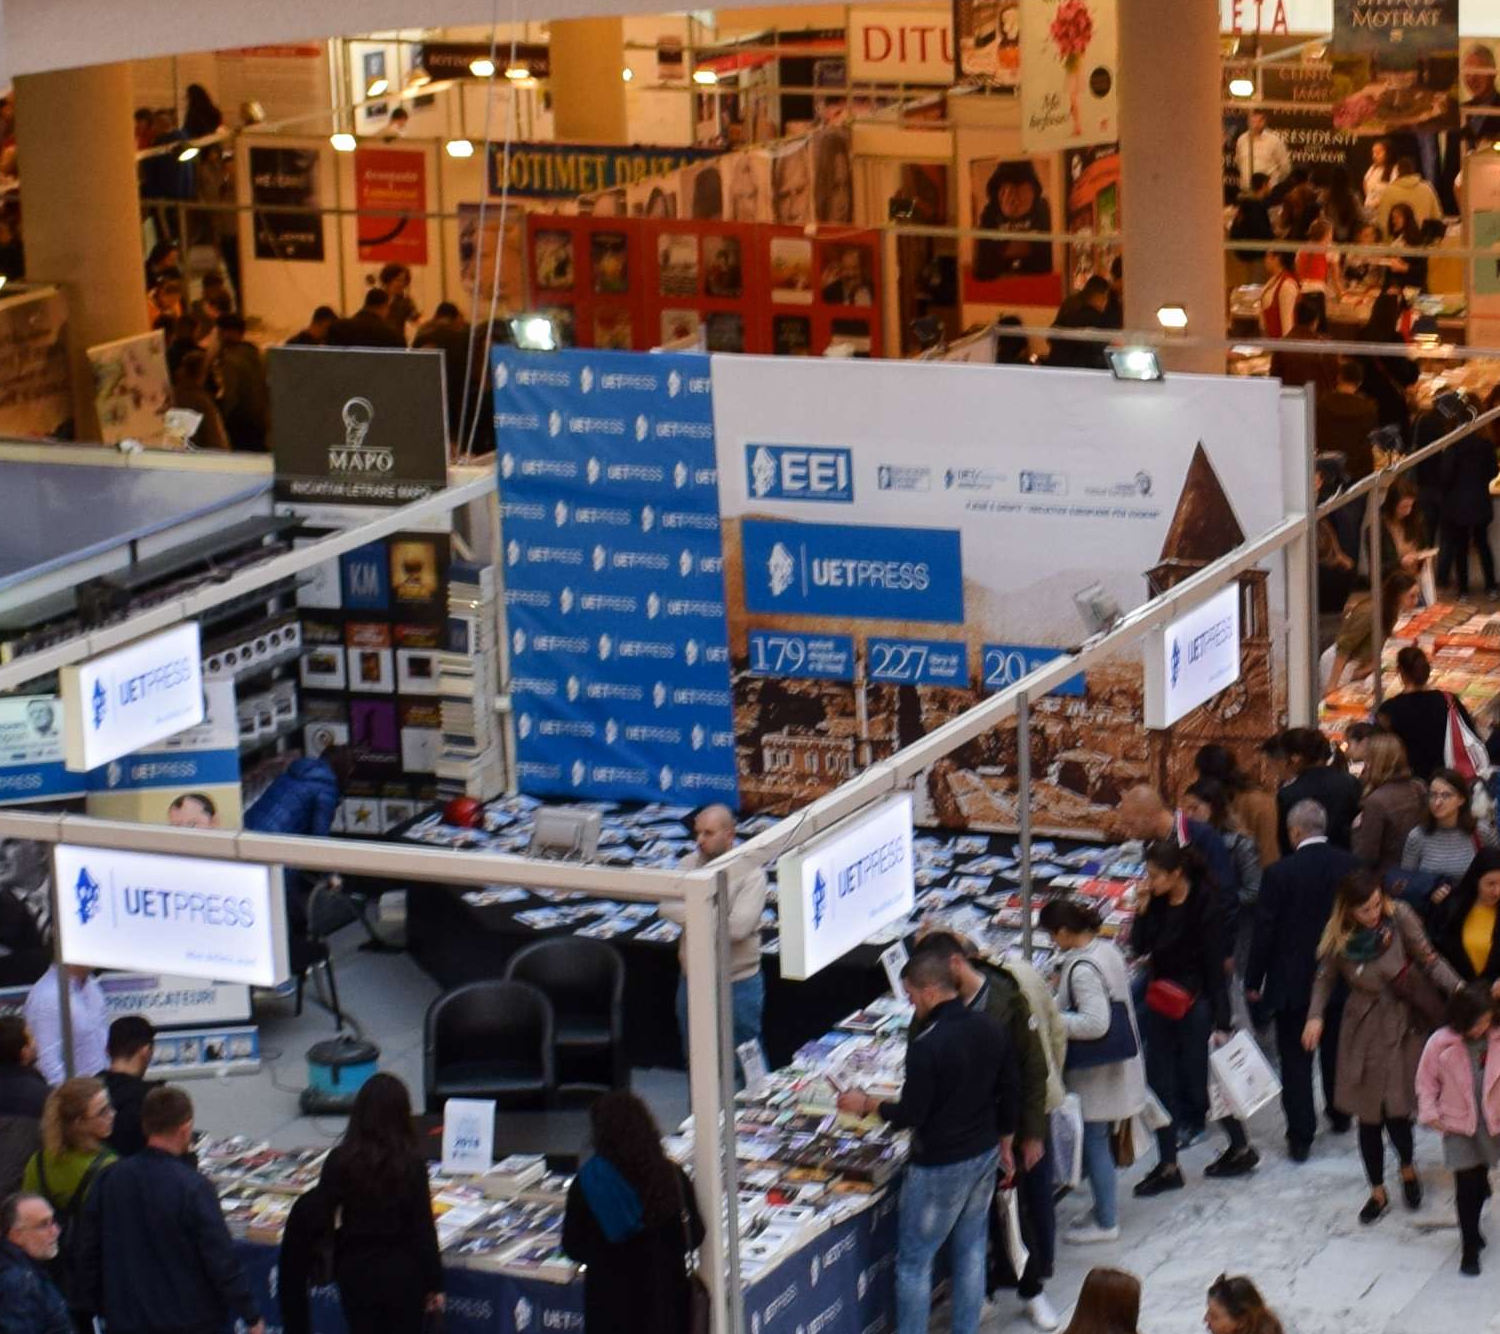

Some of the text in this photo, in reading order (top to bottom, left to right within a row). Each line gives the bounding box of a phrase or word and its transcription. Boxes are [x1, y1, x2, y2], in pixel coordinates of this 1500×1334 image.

[495, 150, 606, 190] BOTIMET
[328, 452, 394, 472] MAPO
[781, 452, 846, 492] EEI
[812, 557, 930, 592] UETPRESS
[750, 635, 806, 674] 179
[870, 643, 929, 681] 227
[119, 656, 192, 707] UETPRESS
[838, 833, 905, 900] UETPRESS
[125, 886, 255, 929] UETPRESS
